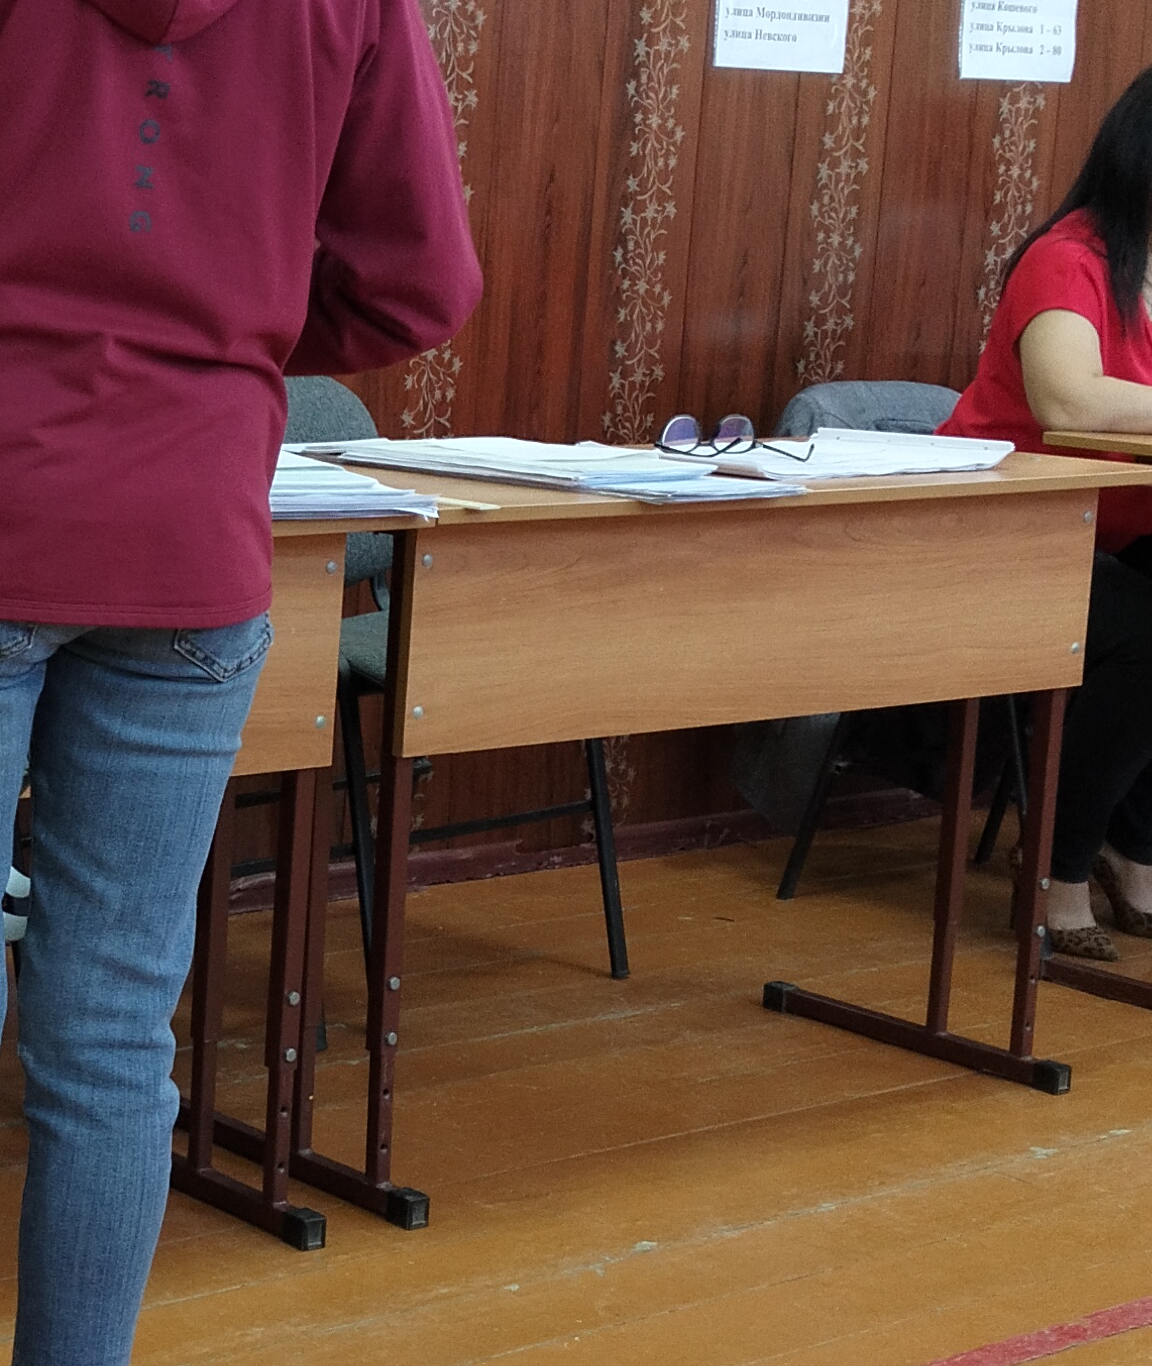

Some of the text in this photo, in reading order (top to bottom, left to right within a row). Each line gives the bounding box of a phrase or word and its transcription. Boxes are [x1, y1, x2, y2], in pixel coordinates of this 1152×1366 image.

[725, 6, 754, 18] улица
[724, 29, 798, 42] улица Невского
